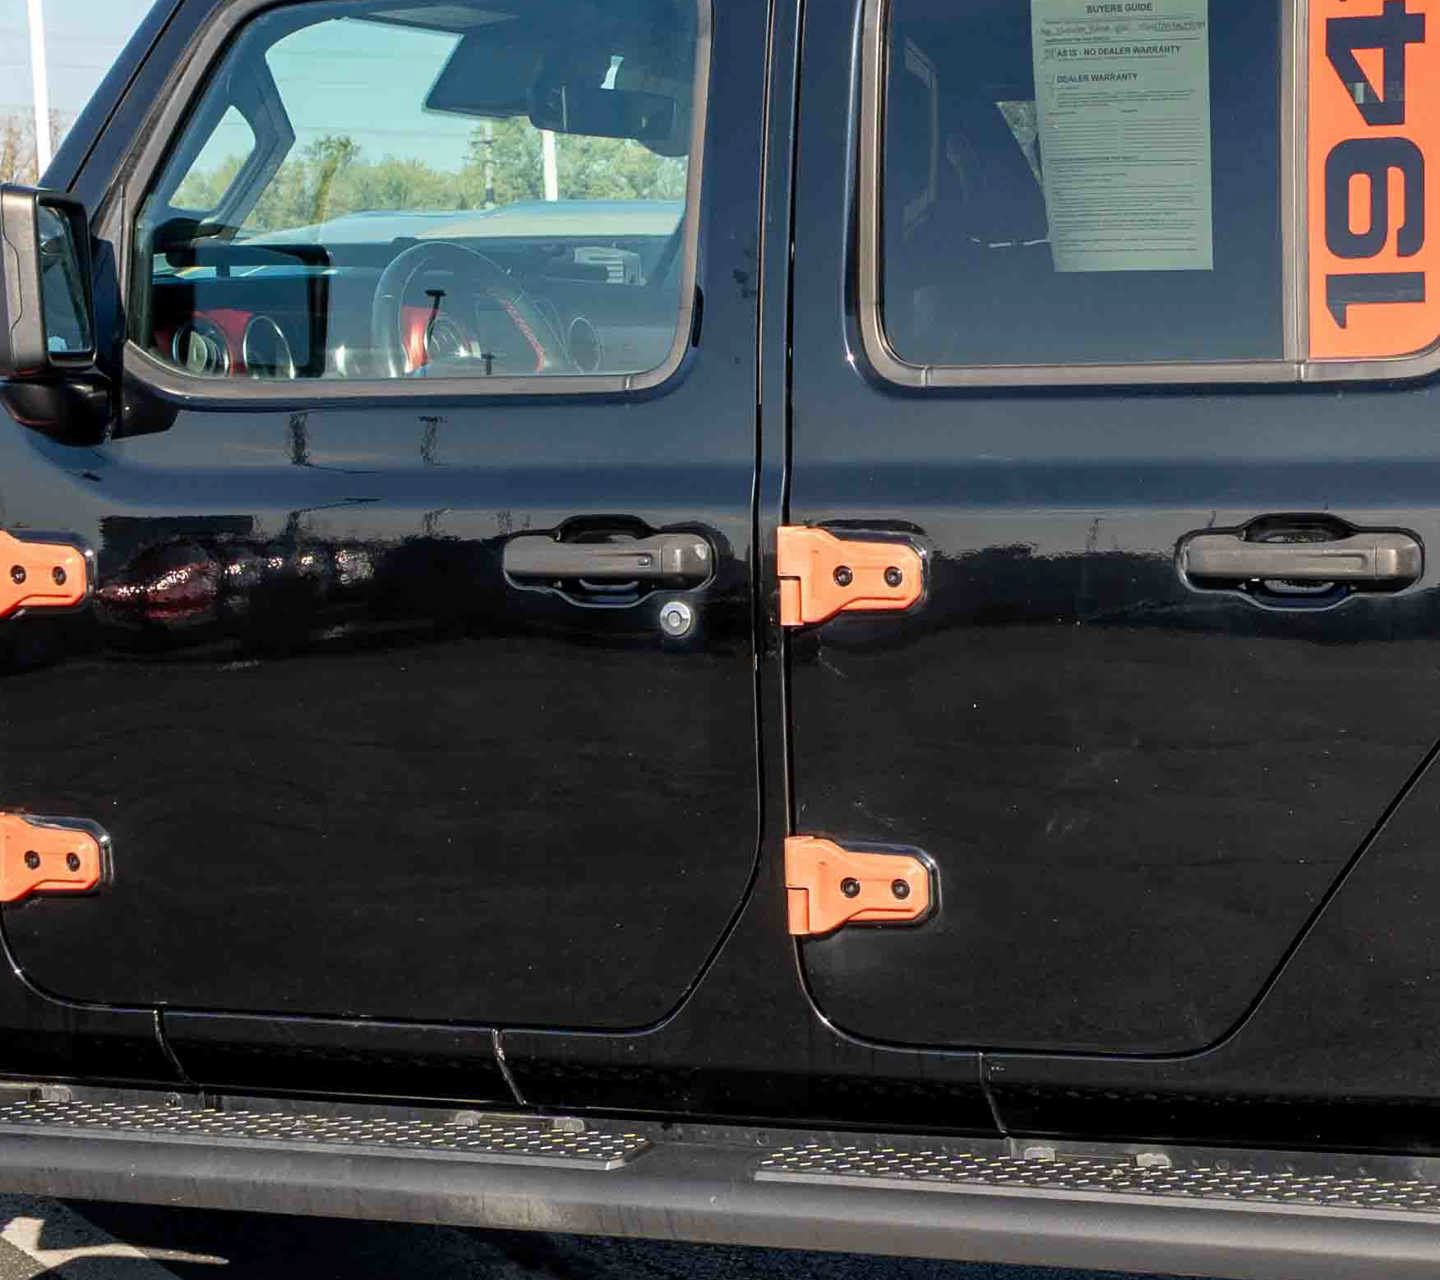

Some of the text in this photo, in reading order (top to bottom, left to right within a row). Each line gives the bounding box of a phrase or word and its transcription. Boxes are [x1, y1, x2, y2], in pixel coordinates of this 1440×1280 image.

[1086, 2, 1153, 14] BUYERS GUIDE
[1083, 48, 1096, 56] NO
[1098, 47, 1131, 56] DEALER
[1133, 46, 1181, 55] WARRANTY
[1056, 72, 1138, 84] DEALER WARRANTY
